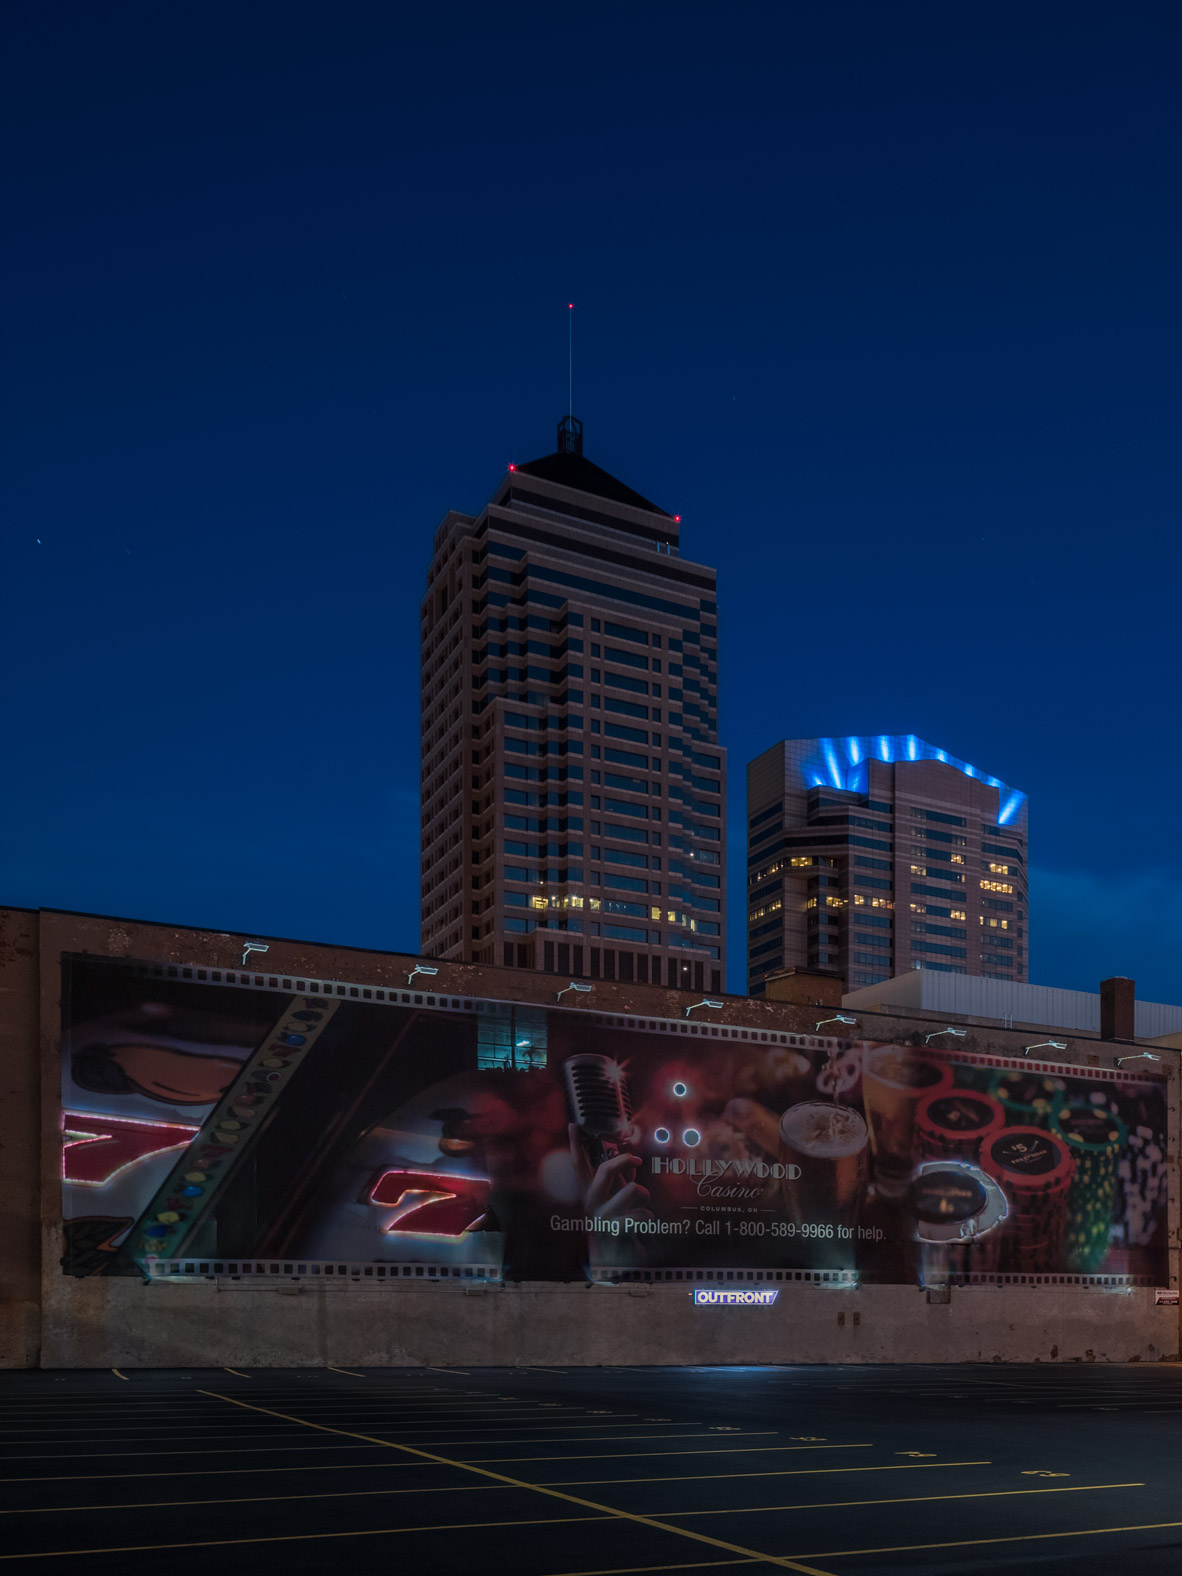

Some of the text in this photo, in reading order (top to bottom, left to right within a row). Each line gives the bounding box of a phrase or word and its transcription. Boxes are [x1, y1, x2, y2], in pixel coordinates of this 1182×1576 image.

[651, 1156, 802, 1180] HOLLYWOOD
[690, 1175, 761, 1199] Casino
[550, 1215, 887, 1242] Gambling Problem? Call 1-800-589-9966 for help.
[697, 1291, 774, 1303] OUTFRONT
